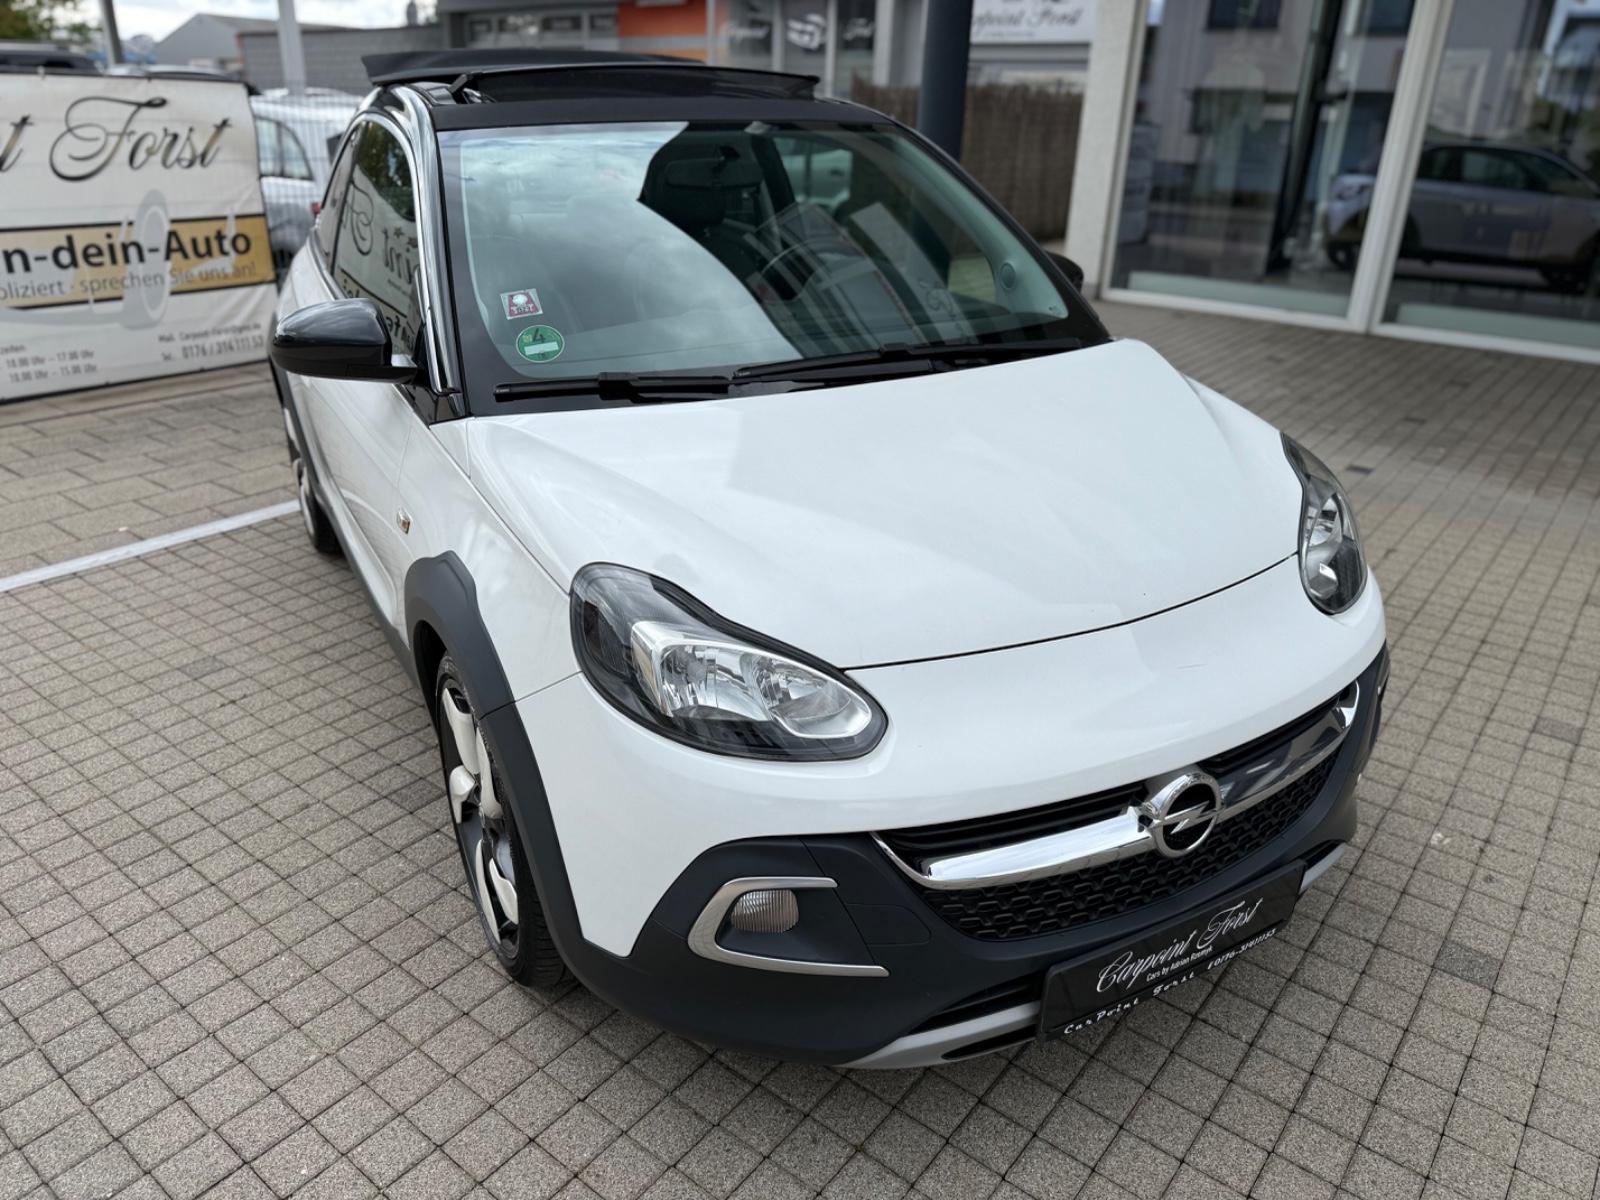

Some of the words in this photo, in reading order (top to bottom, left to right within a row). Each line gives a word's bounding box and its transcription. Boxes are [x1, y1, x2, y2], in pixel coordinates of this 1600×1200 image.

[50, 96, 232, 182] Forst
[2, 229, 252, 275] n-dein-Auto
[79, 271, 165, 296] sprechen
[1097, 929, 1198, 993] Carpoint
[1196, 897, 1264, 950] Forst
